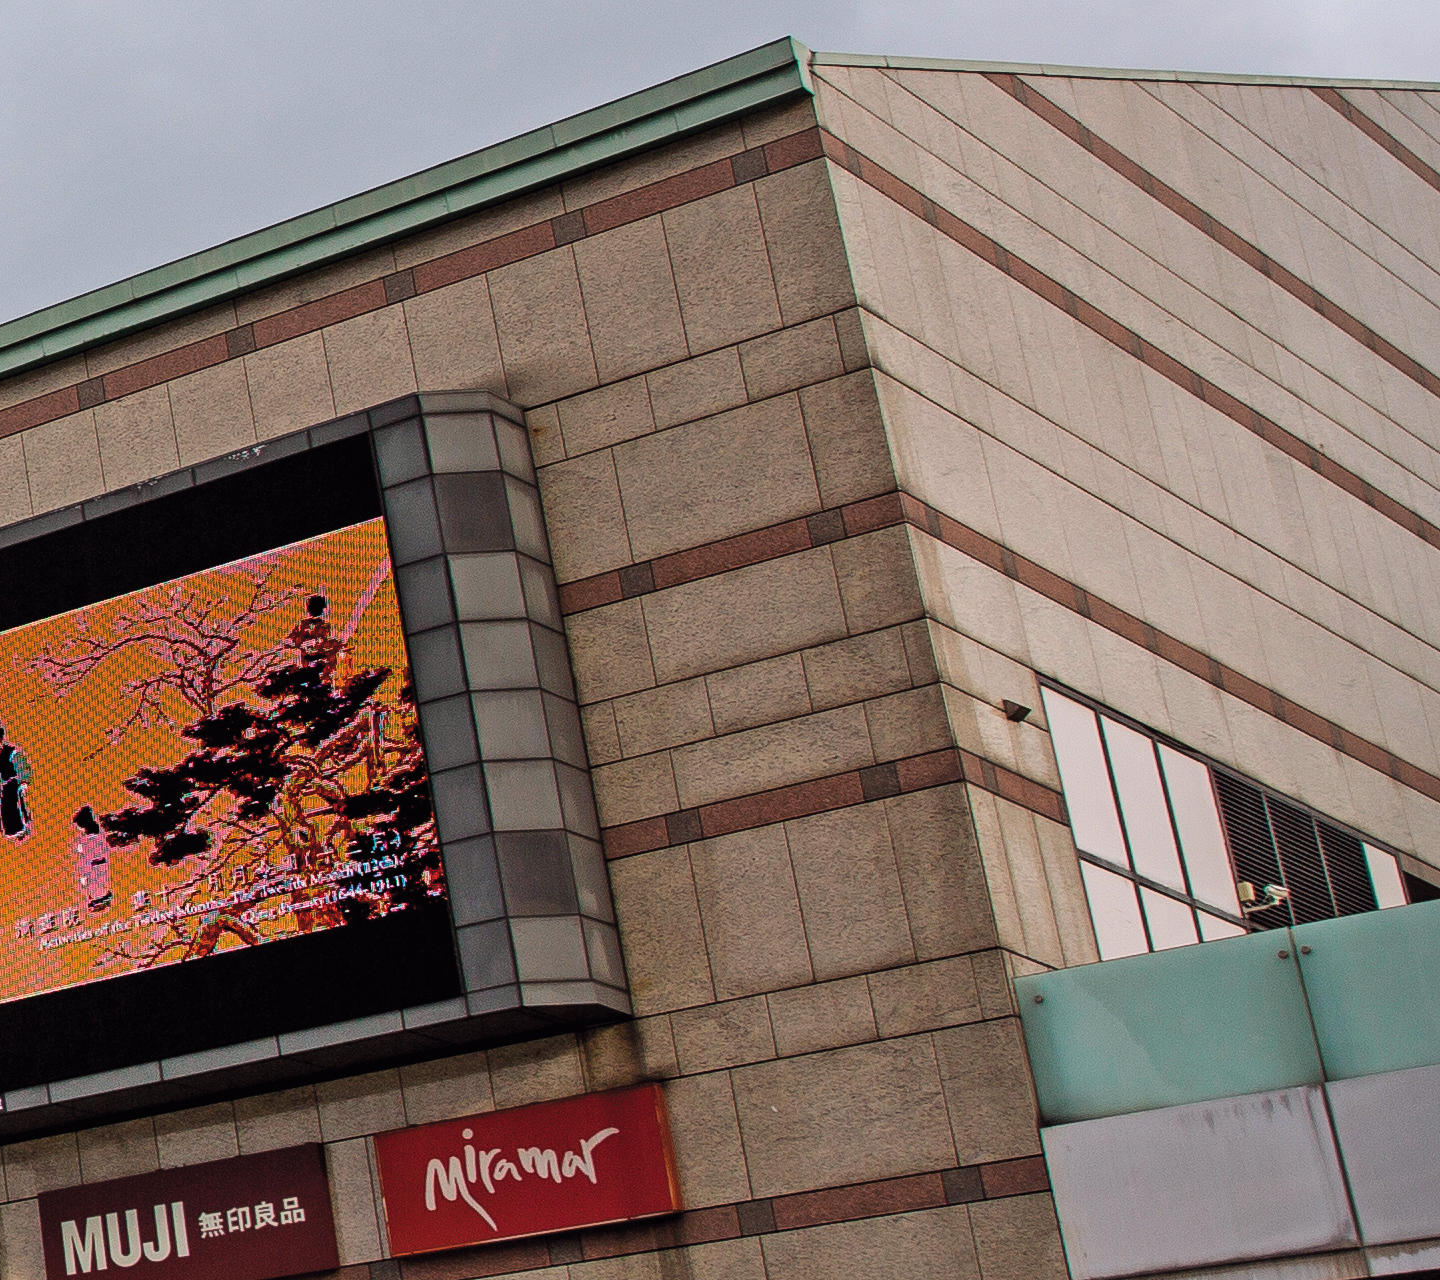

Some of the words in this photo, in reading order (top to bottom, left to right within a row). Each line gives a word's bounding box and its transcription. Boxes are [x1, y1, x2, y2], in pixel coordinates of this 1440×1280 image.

[423, 1127, 619, 1232] Miramar
[60, 1200, 191, 1277] MUJI
[197, 1195, 307, 1237] 無印良品
